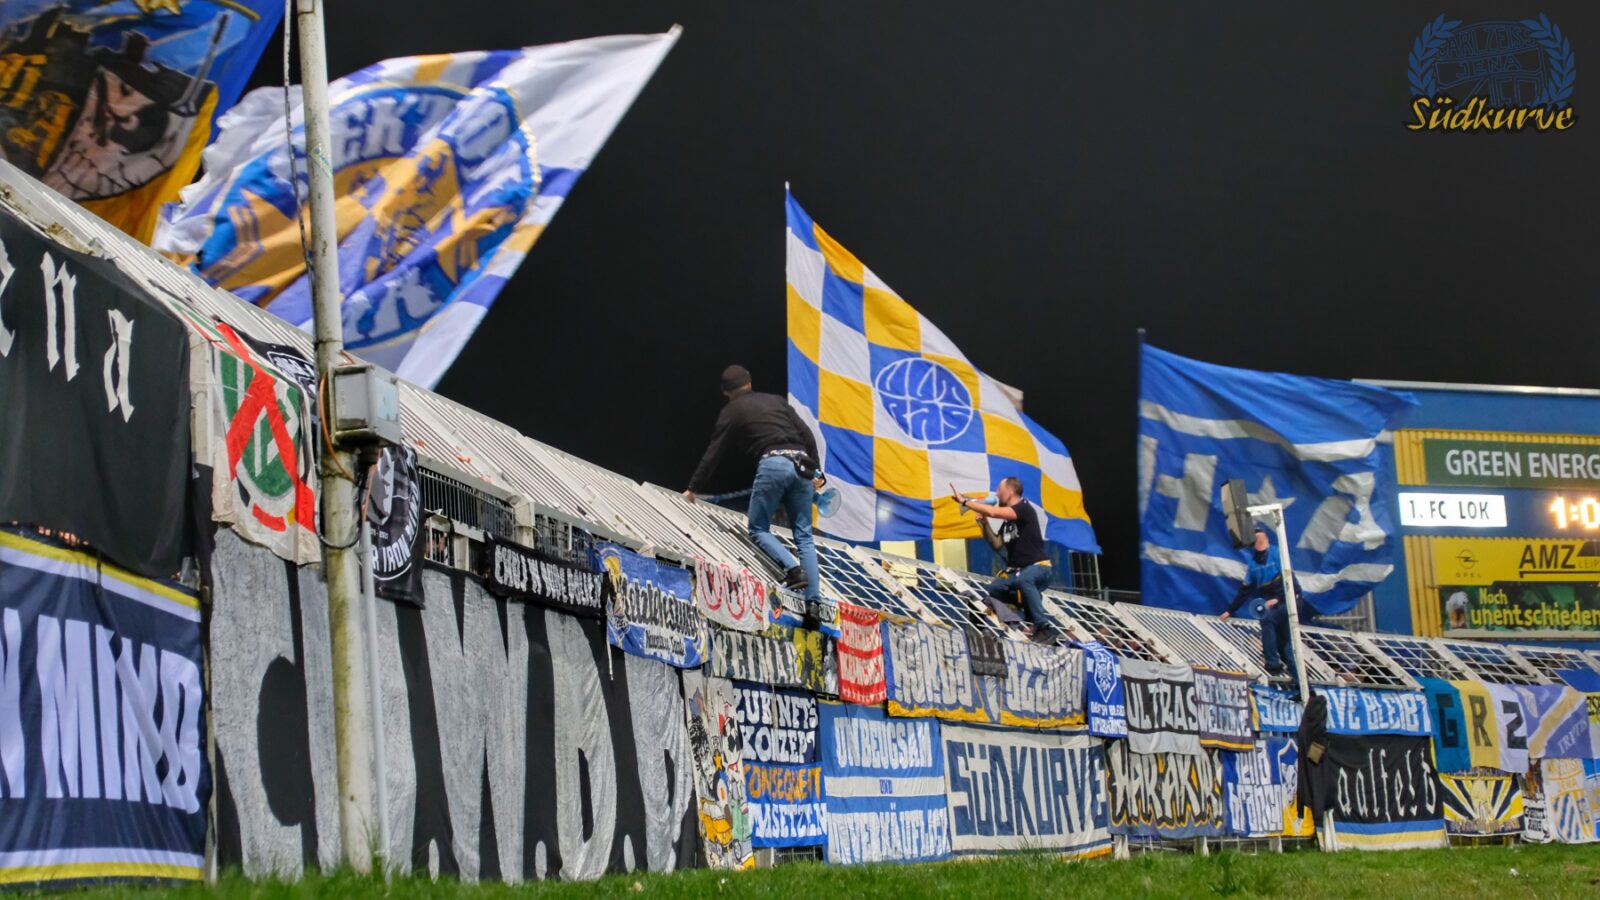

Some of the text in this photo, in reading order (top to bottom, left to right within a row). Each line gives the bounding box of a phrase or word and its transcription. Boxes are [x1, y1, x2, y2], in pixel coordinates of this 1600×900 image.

[1445, 449, 1600, 479] GREEN ENERG
[1409, 500, 1490, 520] 1. FC LOK
[1549, 496, 1600, 529] 1:0
[1518, 544, 1576, 569] AMZ
[1470, 600, 1600, 626] unentschieden
[1479, 586, 1508, 605] Noch
[36, 612, 200, 815] MIND
[732, 688, 819, 729] ZUKNFTS
[1124, 681, 1199, 732] ULTRAS
[1198, 703, 1252, 737] WELCOME
[1362, 690, 1432, 733] BLEIBT
[739, 724, 816, 763] KONZEPT
[833, 716, 934, 769] UNBEUGSAM
[945, 739, 1107, 837] SÜDKURVE
[1337, 746, 1438, 823] aalfeld
